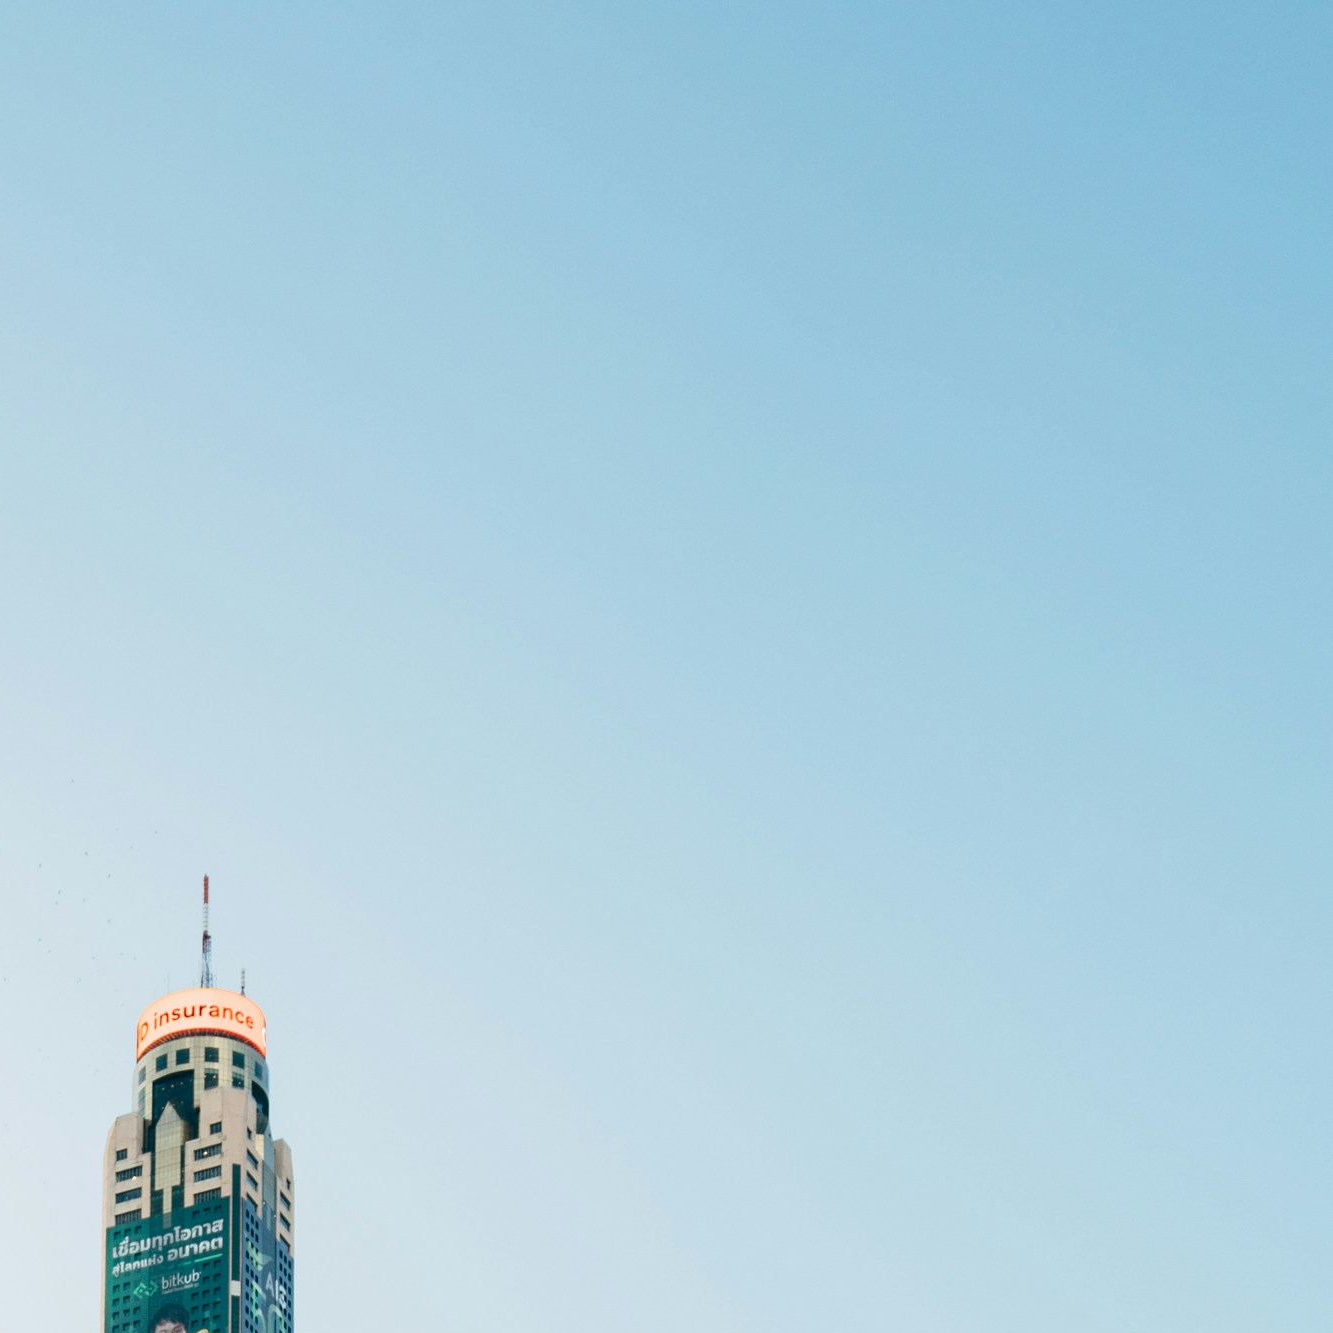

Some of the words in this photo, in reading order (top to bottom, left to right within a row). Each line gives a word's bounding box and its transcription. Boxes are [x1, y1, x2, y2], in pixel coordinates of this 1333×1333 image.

[154, 1005, 254, 1030] insurance
[112, 1219, 224, 1258] เชื่อมทุกโอกาส
[167, 1237, 223, 1262] อนาคต
[161, 1269, 200, 1289] bitkub
